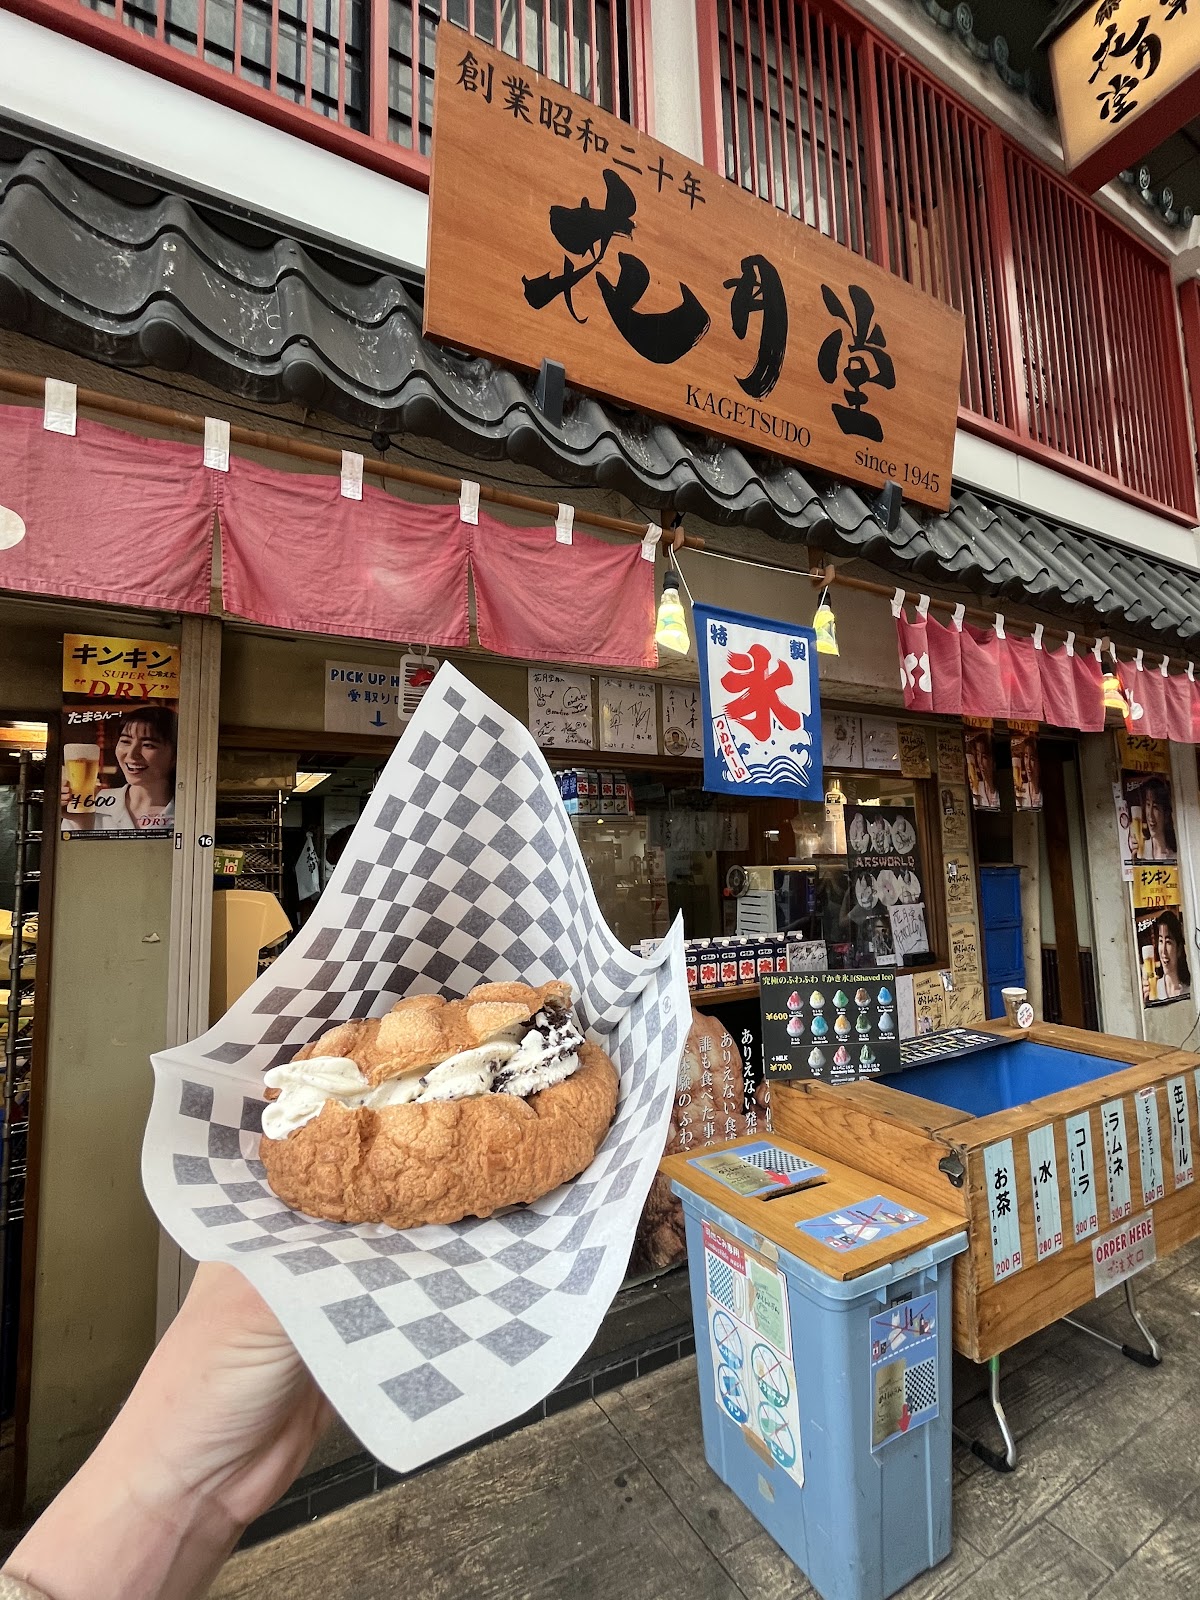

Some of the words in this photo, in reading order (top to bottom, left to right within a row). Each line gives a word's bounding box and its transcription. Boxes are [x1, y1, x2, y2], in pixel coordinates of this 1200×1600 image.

[456, 50, 706, 209] 創業昭和二十年
[521, 169, 896, 443] 花月堂
[685, 384, 811, 448] KAGETSUDO
[854, 446, 897, 478] since
[903, 463, 940, 493] 1945
[711, 624, 728, 647] 特
[71, 643, 172, 669] キンキン
[102, 669, 145, 680] SUPER
[330, 668, 364, 684] PICK
[368, 672, 387, 686] UP
[720, 643, 802, 742] 氷
[71, 795, 116, 809] ¥600
[200, 837, 212, 846] 16
[1141, 869, 1171, 886] キンキン
[765, 1012, 788, 1021] ¥600
[769, 1063, 793, 1072] ¥700
[1108, 1111, 1124, 1177] ラムネ
[1173, 1085, 1188, 1168] 缶ビール
[1039, 1160, 1053, 1184] 水
[1070, 1152, 1078, 1197] Cola
[1075, 1127, 1090, 1195] コーラ
[994, 1167, 1011, 1218] お茶
[1096, 1233, 1127, 1264] ORDER
[1129, 1219, 1153, 1245] HERE
[995, 1251, 1021, 1277] 200円
